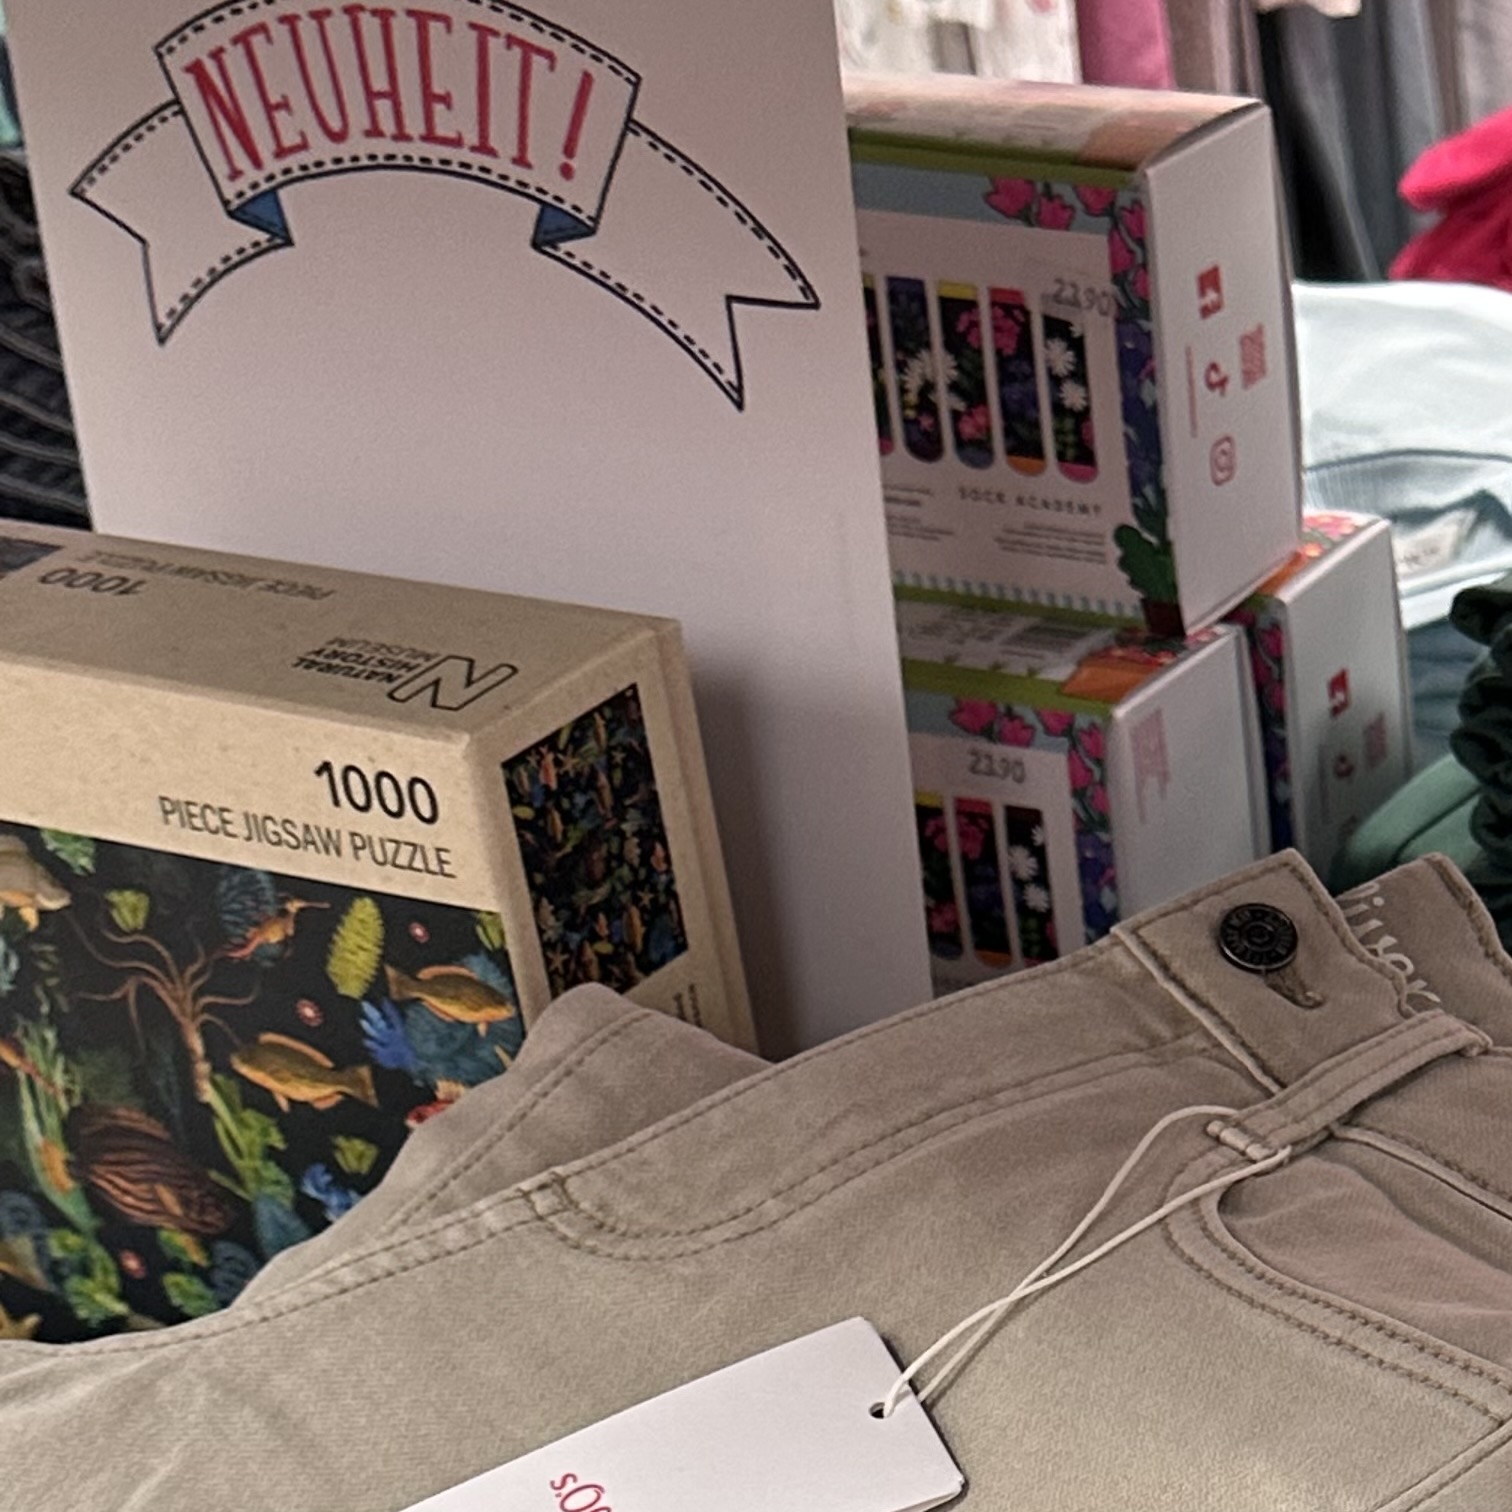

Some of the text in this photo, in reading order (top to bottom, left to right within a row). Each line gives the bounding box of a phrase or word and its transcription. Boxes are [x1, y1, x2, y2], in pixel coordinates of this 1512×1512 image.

[181, 4, 595, 182] NEUHEIT!
[38, 566, 147, 596] 1000
[304, 647, 421, 673] HISTORY
[324, 636, 441, 662] MUSEUM
[291, 656, 405, 684] NATURAL
[313, 760, 439, 825] 1000
[157, 796, 458, 879] PIECE JIGSAW PUZZLE
